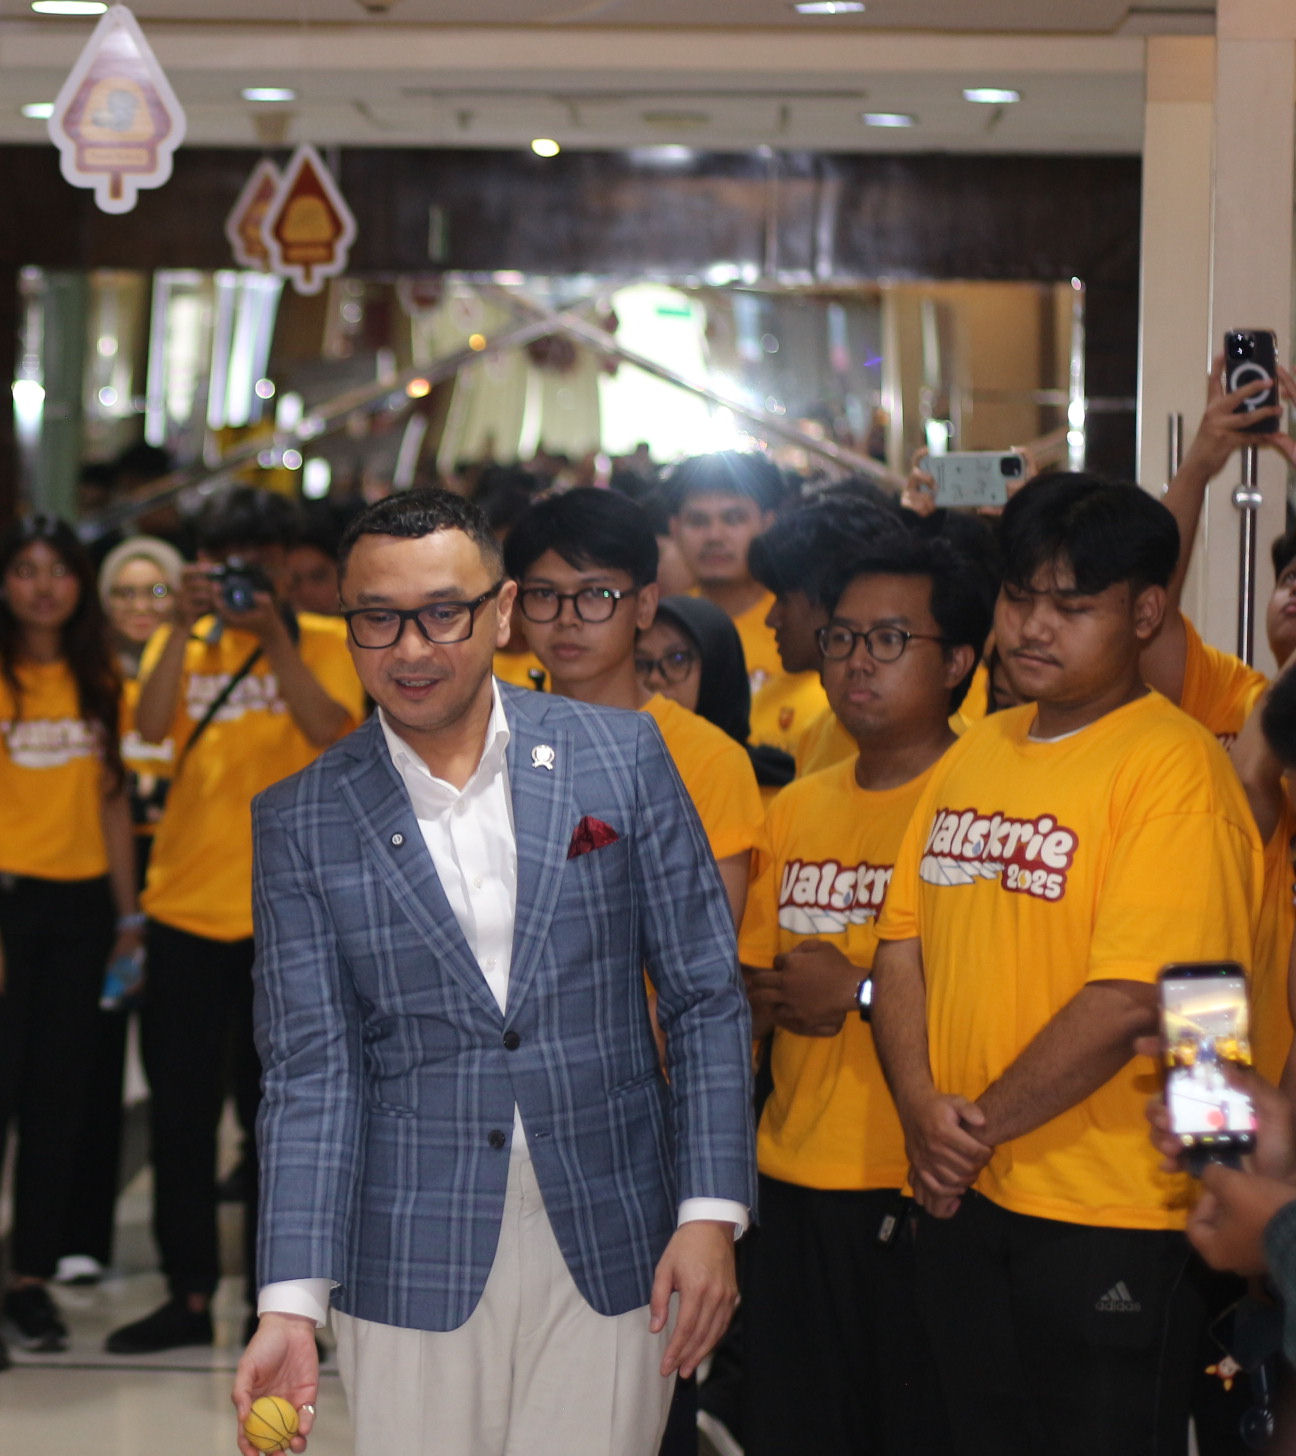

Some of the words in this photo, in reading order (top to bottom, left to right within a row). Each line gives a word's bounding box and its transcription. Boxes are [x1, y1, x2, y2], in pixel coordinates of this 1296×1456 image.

[924, 811, 1074, 869] Valskrie
[1007, 864, 1063, 899] 2025
[1095, 1299, 1142, 1312] adidas
